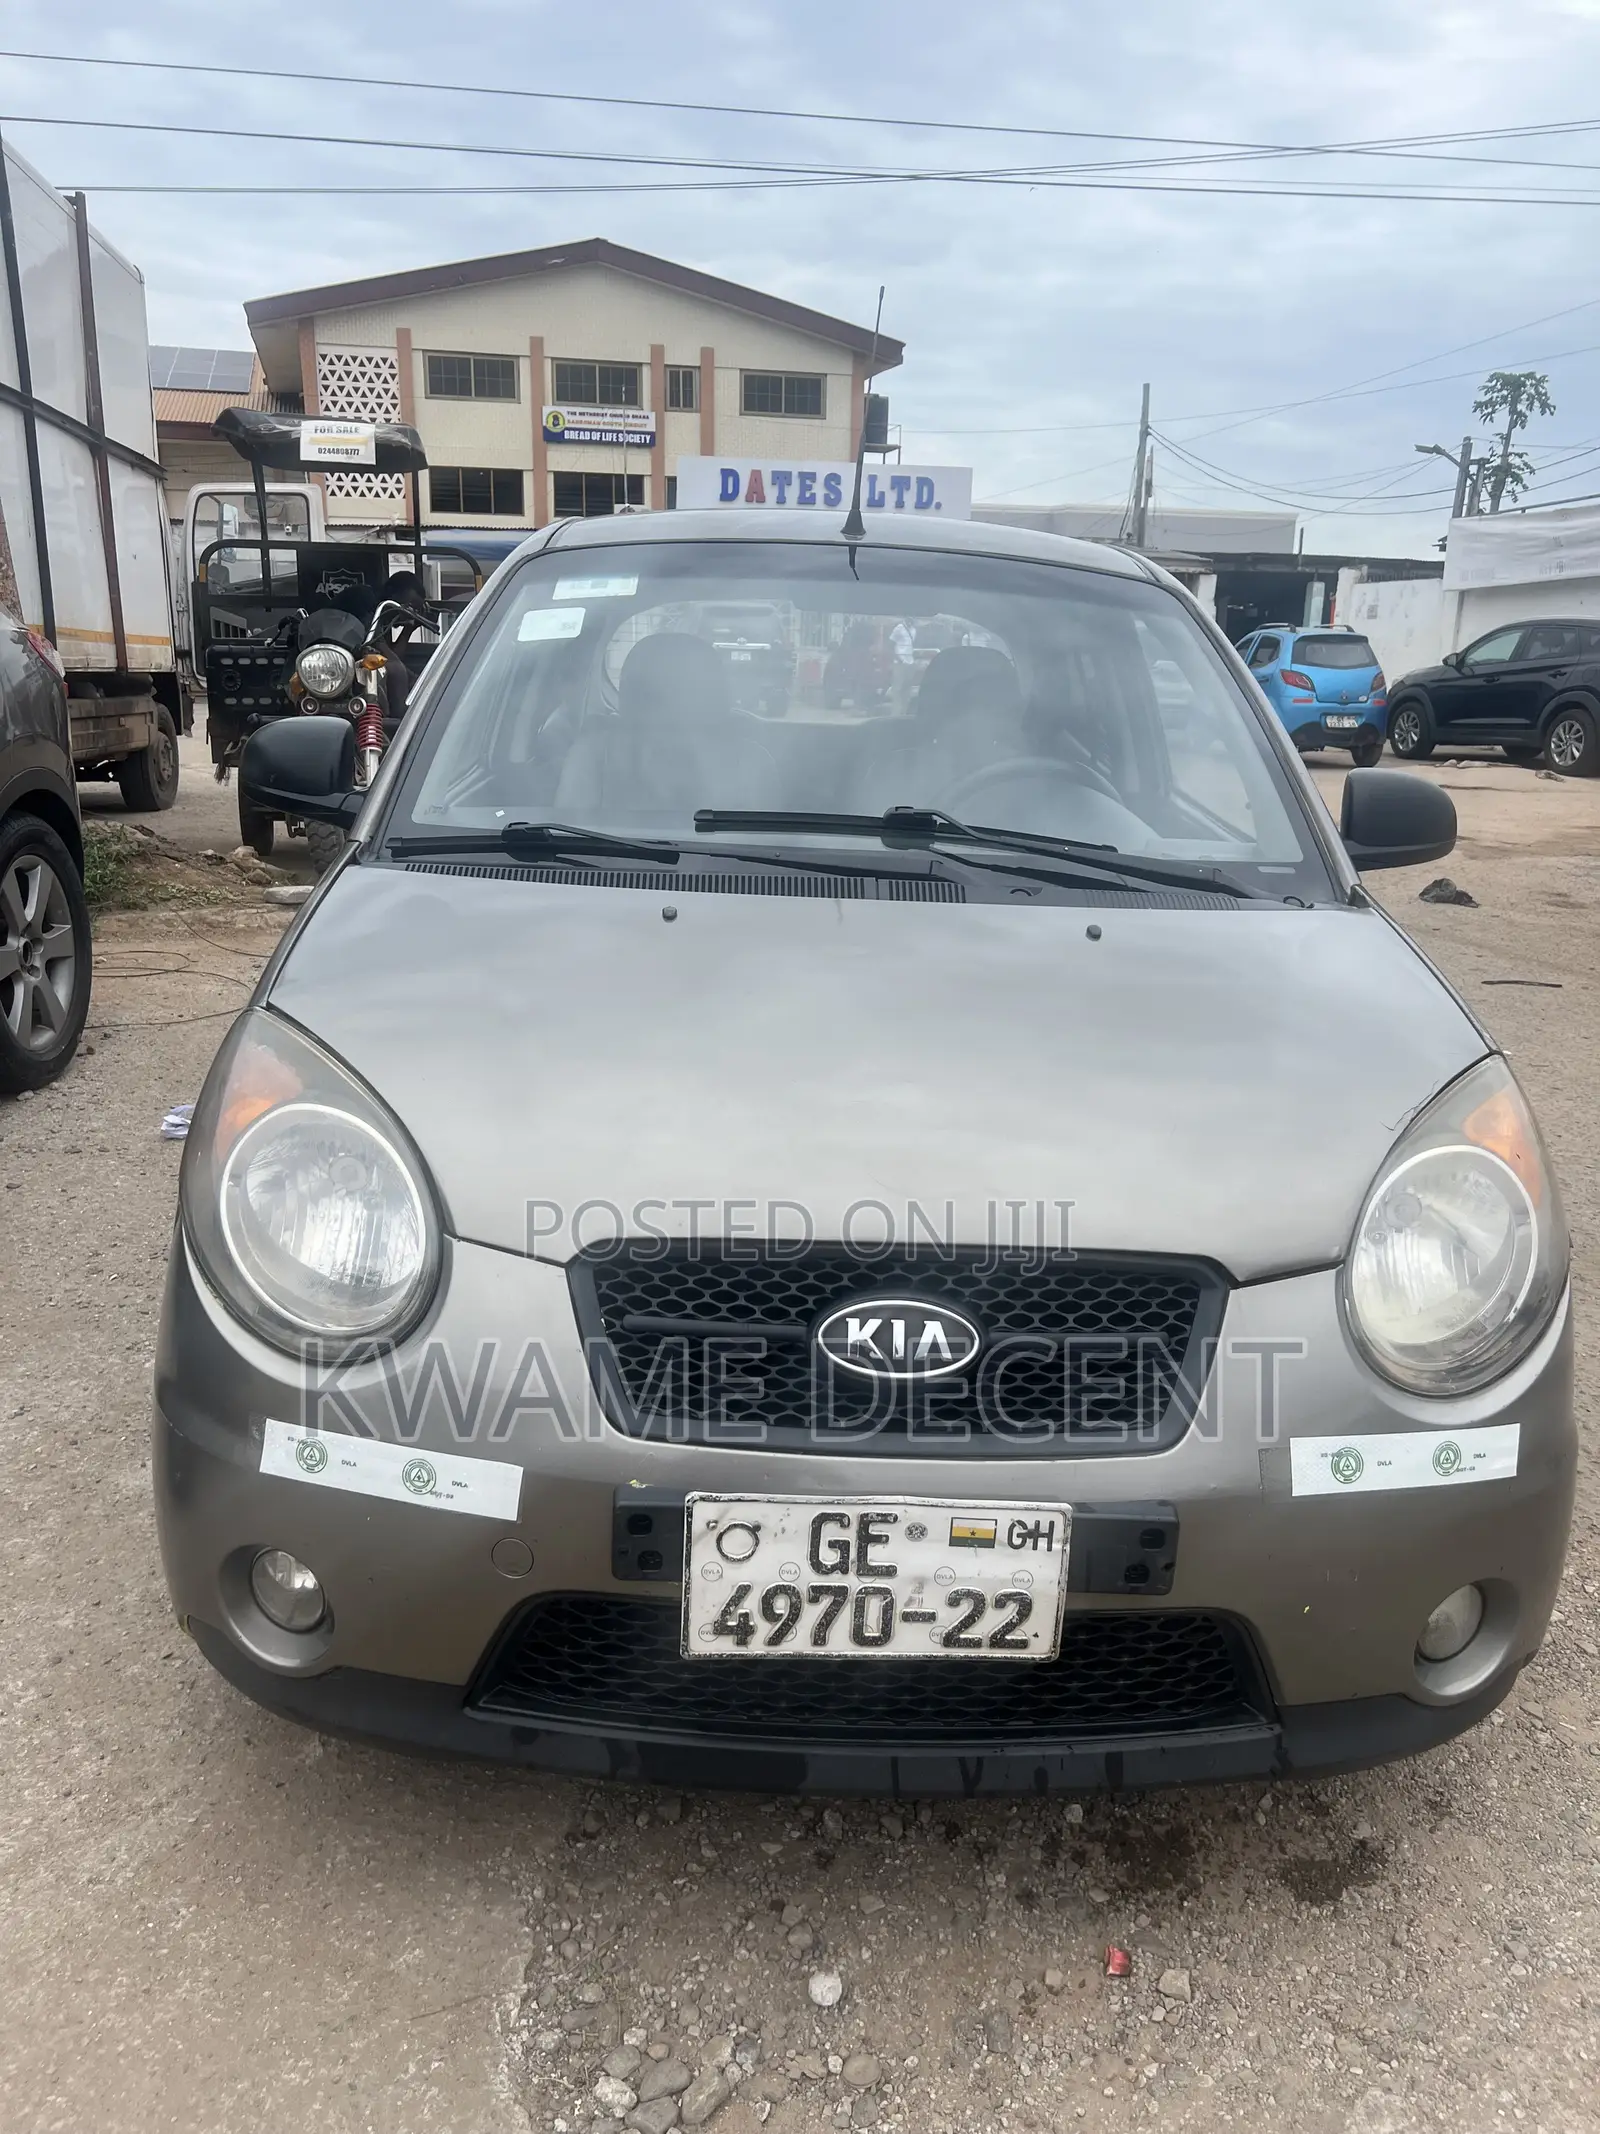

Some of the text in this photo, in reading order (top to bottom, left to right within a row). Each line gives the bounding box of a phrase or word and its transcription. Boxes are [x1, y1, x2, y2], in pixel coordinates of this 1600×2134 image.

[314, 426, 360, 434] FOR SALE
[564, 430, 651, 444] BREAD OF LIFE SOCIETY
[719, 468, 942, 510] DATES LTD.
[846, 1317, 953, 1361] KIA
[341, 1459, 358, 1467] DVLA
[451, 1480, 469, 1488] DVLA
[809, 1511, 898, 1577] GE
[1007, 1519, 1054, 1552] GH
[712, 1583, 1035, 1650] 4970-22
